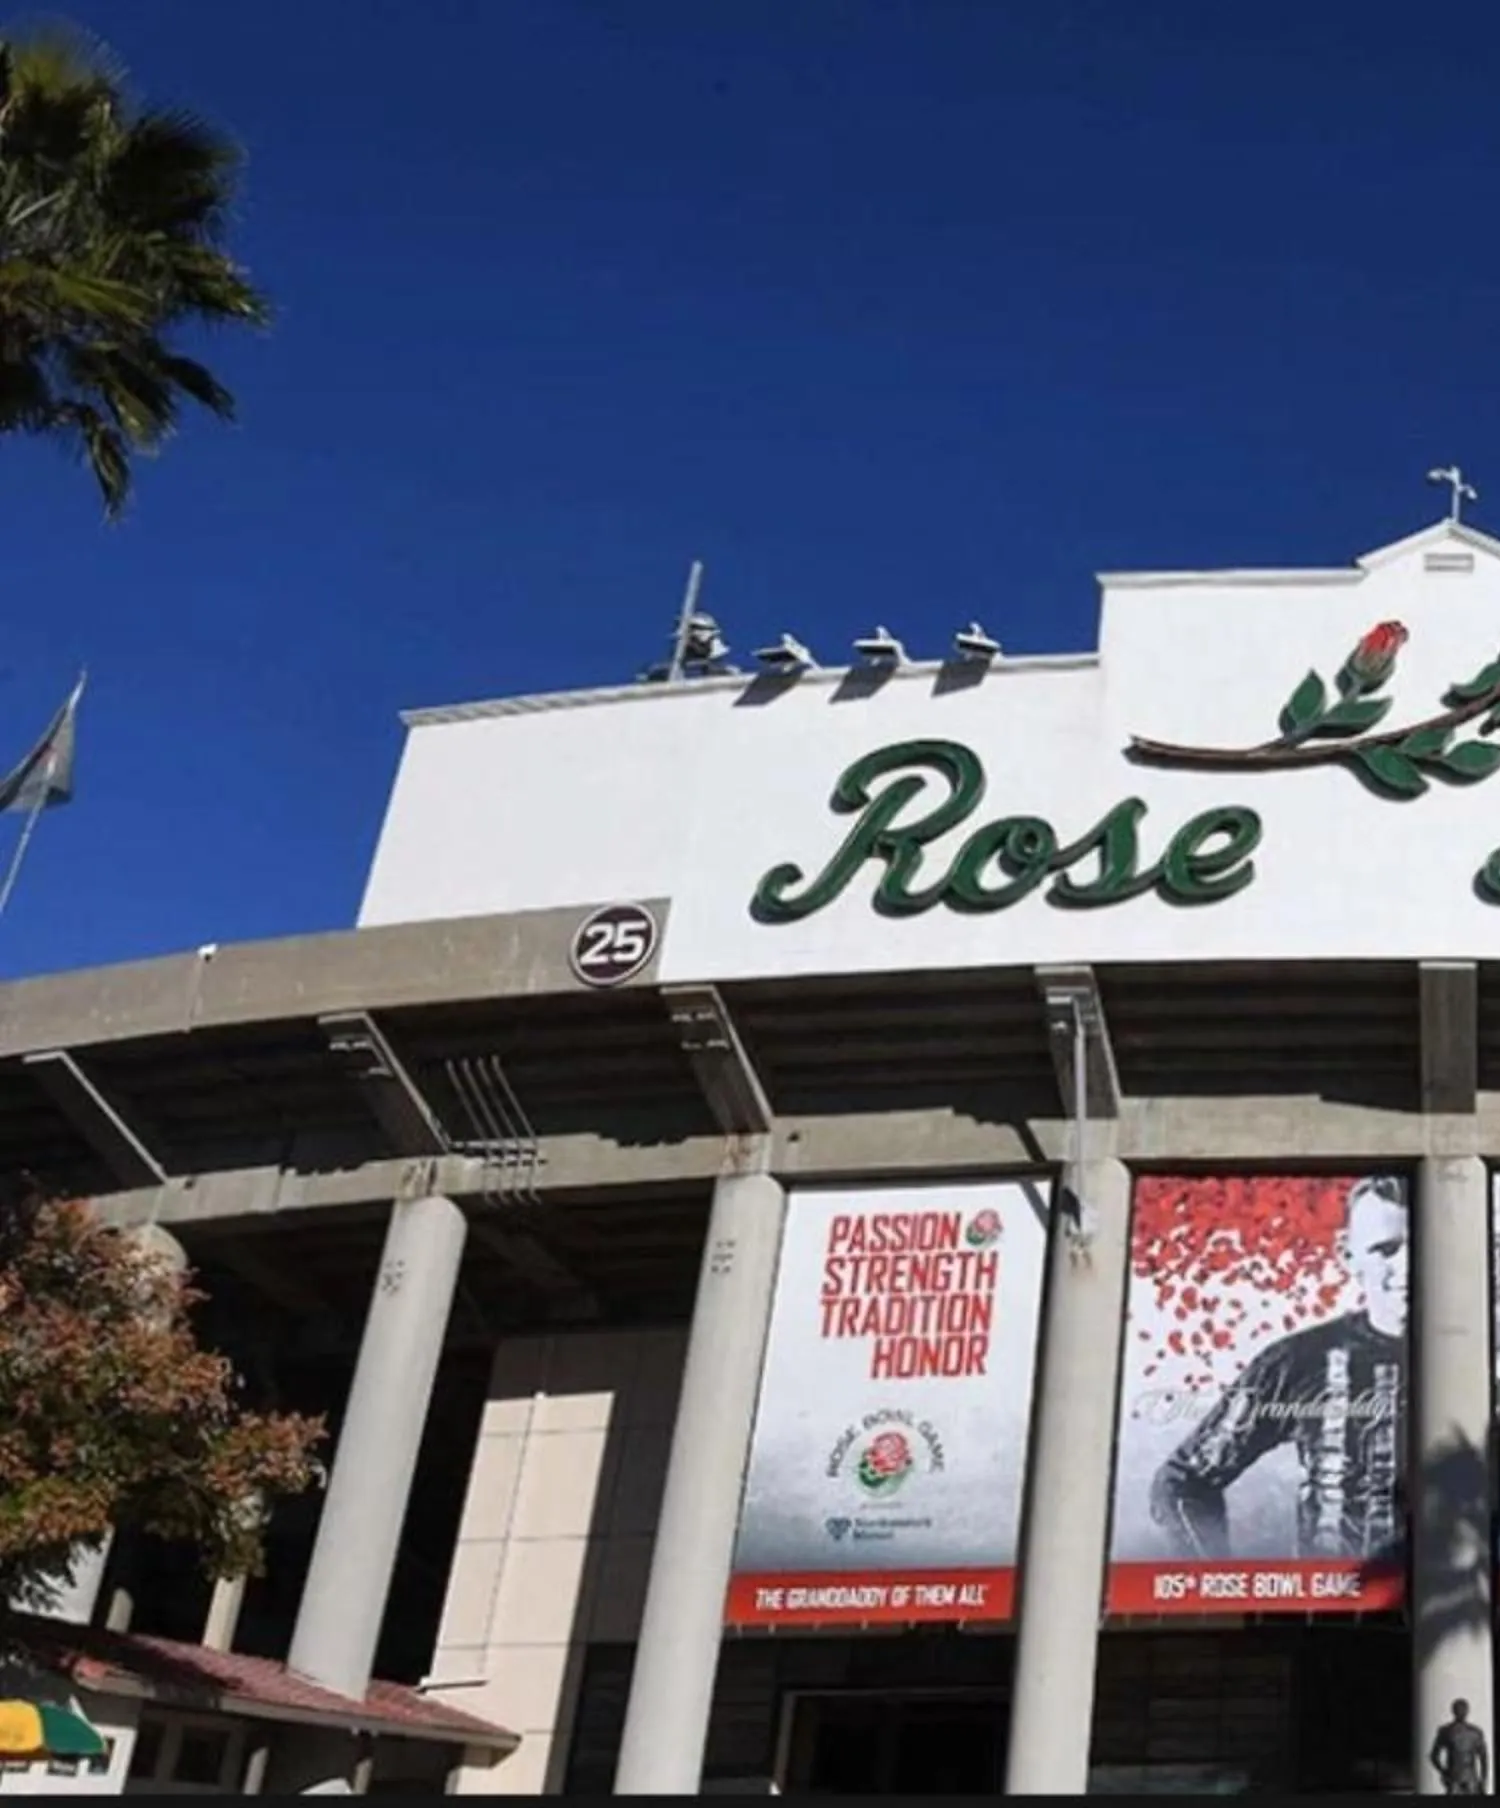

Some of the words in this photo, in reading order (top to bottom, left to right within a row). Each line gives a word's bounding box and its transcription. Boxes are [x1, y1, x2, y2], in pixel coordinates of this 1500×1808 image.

[749, 739, 1261, 925] Rose
[580, 919, 648, 965] 25
[828, 1211, 962, 1254] PASSION
[822, 1251, 999, 1297] STRENGTH
[820, 1294, 995, 1339] TRADITION
[871, 1335, 990, 1380] HONOR
[756, 1587, 783, 1611] THE
[891, 1584, 913, 1608] OF
[914, 1583, 957, 1608] THEM
[958, 1583, 985, 1607] ALL
[1201, 1572, 1249, 1599] ROSE
[1252, 1571, 1306, 1599] BOWL
[1310, 1571, 1361, 1599] GAME
